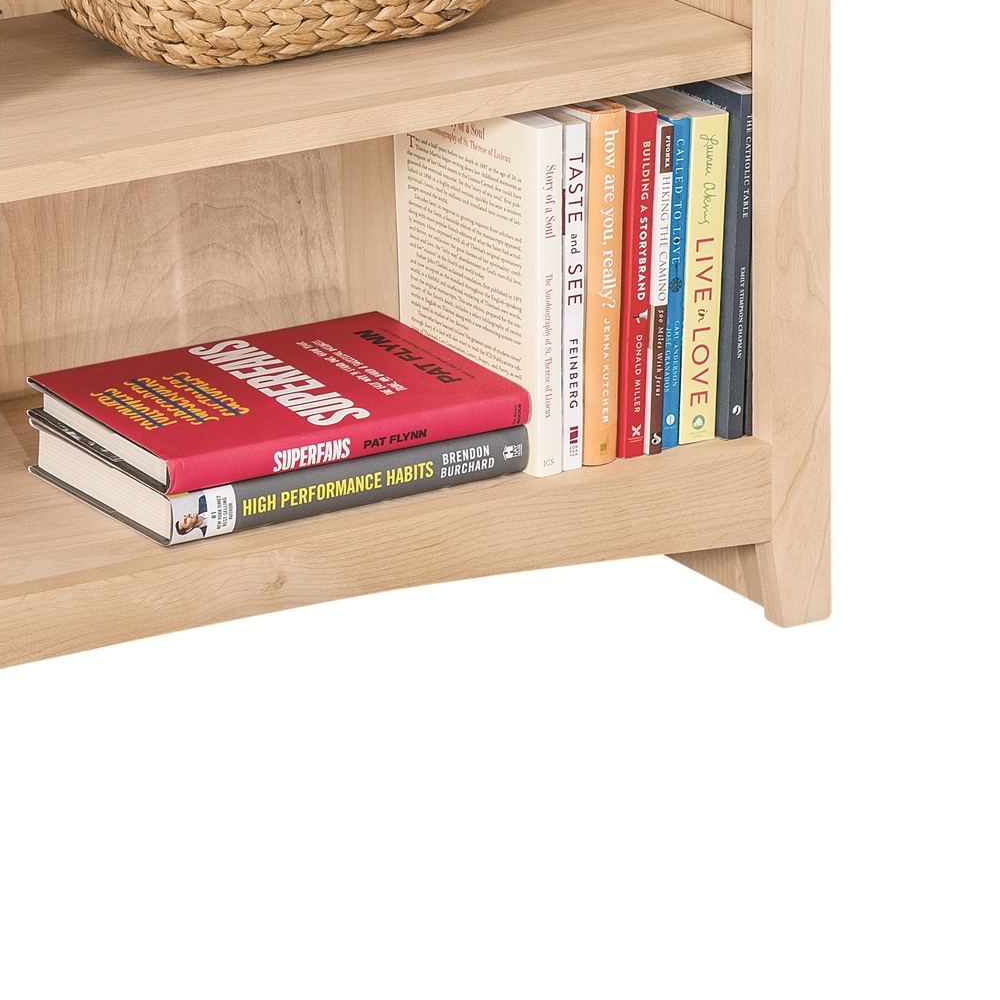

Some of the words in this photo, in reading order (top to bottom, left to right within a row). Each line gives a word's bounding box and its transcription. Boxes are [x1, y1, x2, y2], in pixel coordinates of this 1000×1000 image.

[458, 136, 462, 144] of
[488, 148, 493, 157] of
[466, 125, 469, 133] a
[471, 123, 484, 139] Soul
[604, 128, 619, 168] how
[641, 141, 650, 200] BUILDING
[674, 138, 685, 194] CALLED
[700, 134, 719, 176] Lauren
[743, 136, 752, 186] CATHOLIC
[542, 164, 556, 191] Story
[568, 153, 584, 223] TASTE
[604, 175, 614, 202] are
[545, 195, 555, 204] of
[640, 205, 648, 213] A
[660, 176, 671, 221] HIKING
[674, 201, 682, 220] TO
[698, 182, 716, 225] Akins
[742, 188, 750, 218] TABLE
[545, 216, 556, 239] Soul
[570, 234, 580, 254] and
[600, 207, 614, 246] you,
[659, 225, 669, 248] THE
[637, 217, 648, 300] STORYBRAND
[672, 228, 681, 264] LOVE
[568, 264, 583, 306] SEE
[599, 250, 616, 308] really?
[658, 251, 668, 301] CAMINO
[694, 237, 714, 303] LIVE
[543, 289, 553, 336] Autobiography
[698, 309, 708, 322] in
[353, 329, 424, 362] FLYNN
[545, 338, 552, 346] of
[634, 334, 642, 376] DONALD
[188, 339, 370, 426] SUPERFANS
[412, 363, 462, 383] PAT
[569, 339, 578, 409] FEINBERG
[690, 327, 710, 406] LOVE
[545, 385, 552, 393] of
[602, 364, 610, 423] KUTCHER
[272, 437, 351, 472] SUPERFANS
[363, 436, 387, 449] PAT
[389, 429, 427, 444] FLYNN
[442, 445, 490, 465] BRENDON
[440, 457, 495, 479] BURCHARD
[543, 458, 554, 467] ICS
[242, 493, 276, 516] HIGH
[280, 471, 382, 509] PERFORMANCE
[386, 461, 434, 486] HABITS
